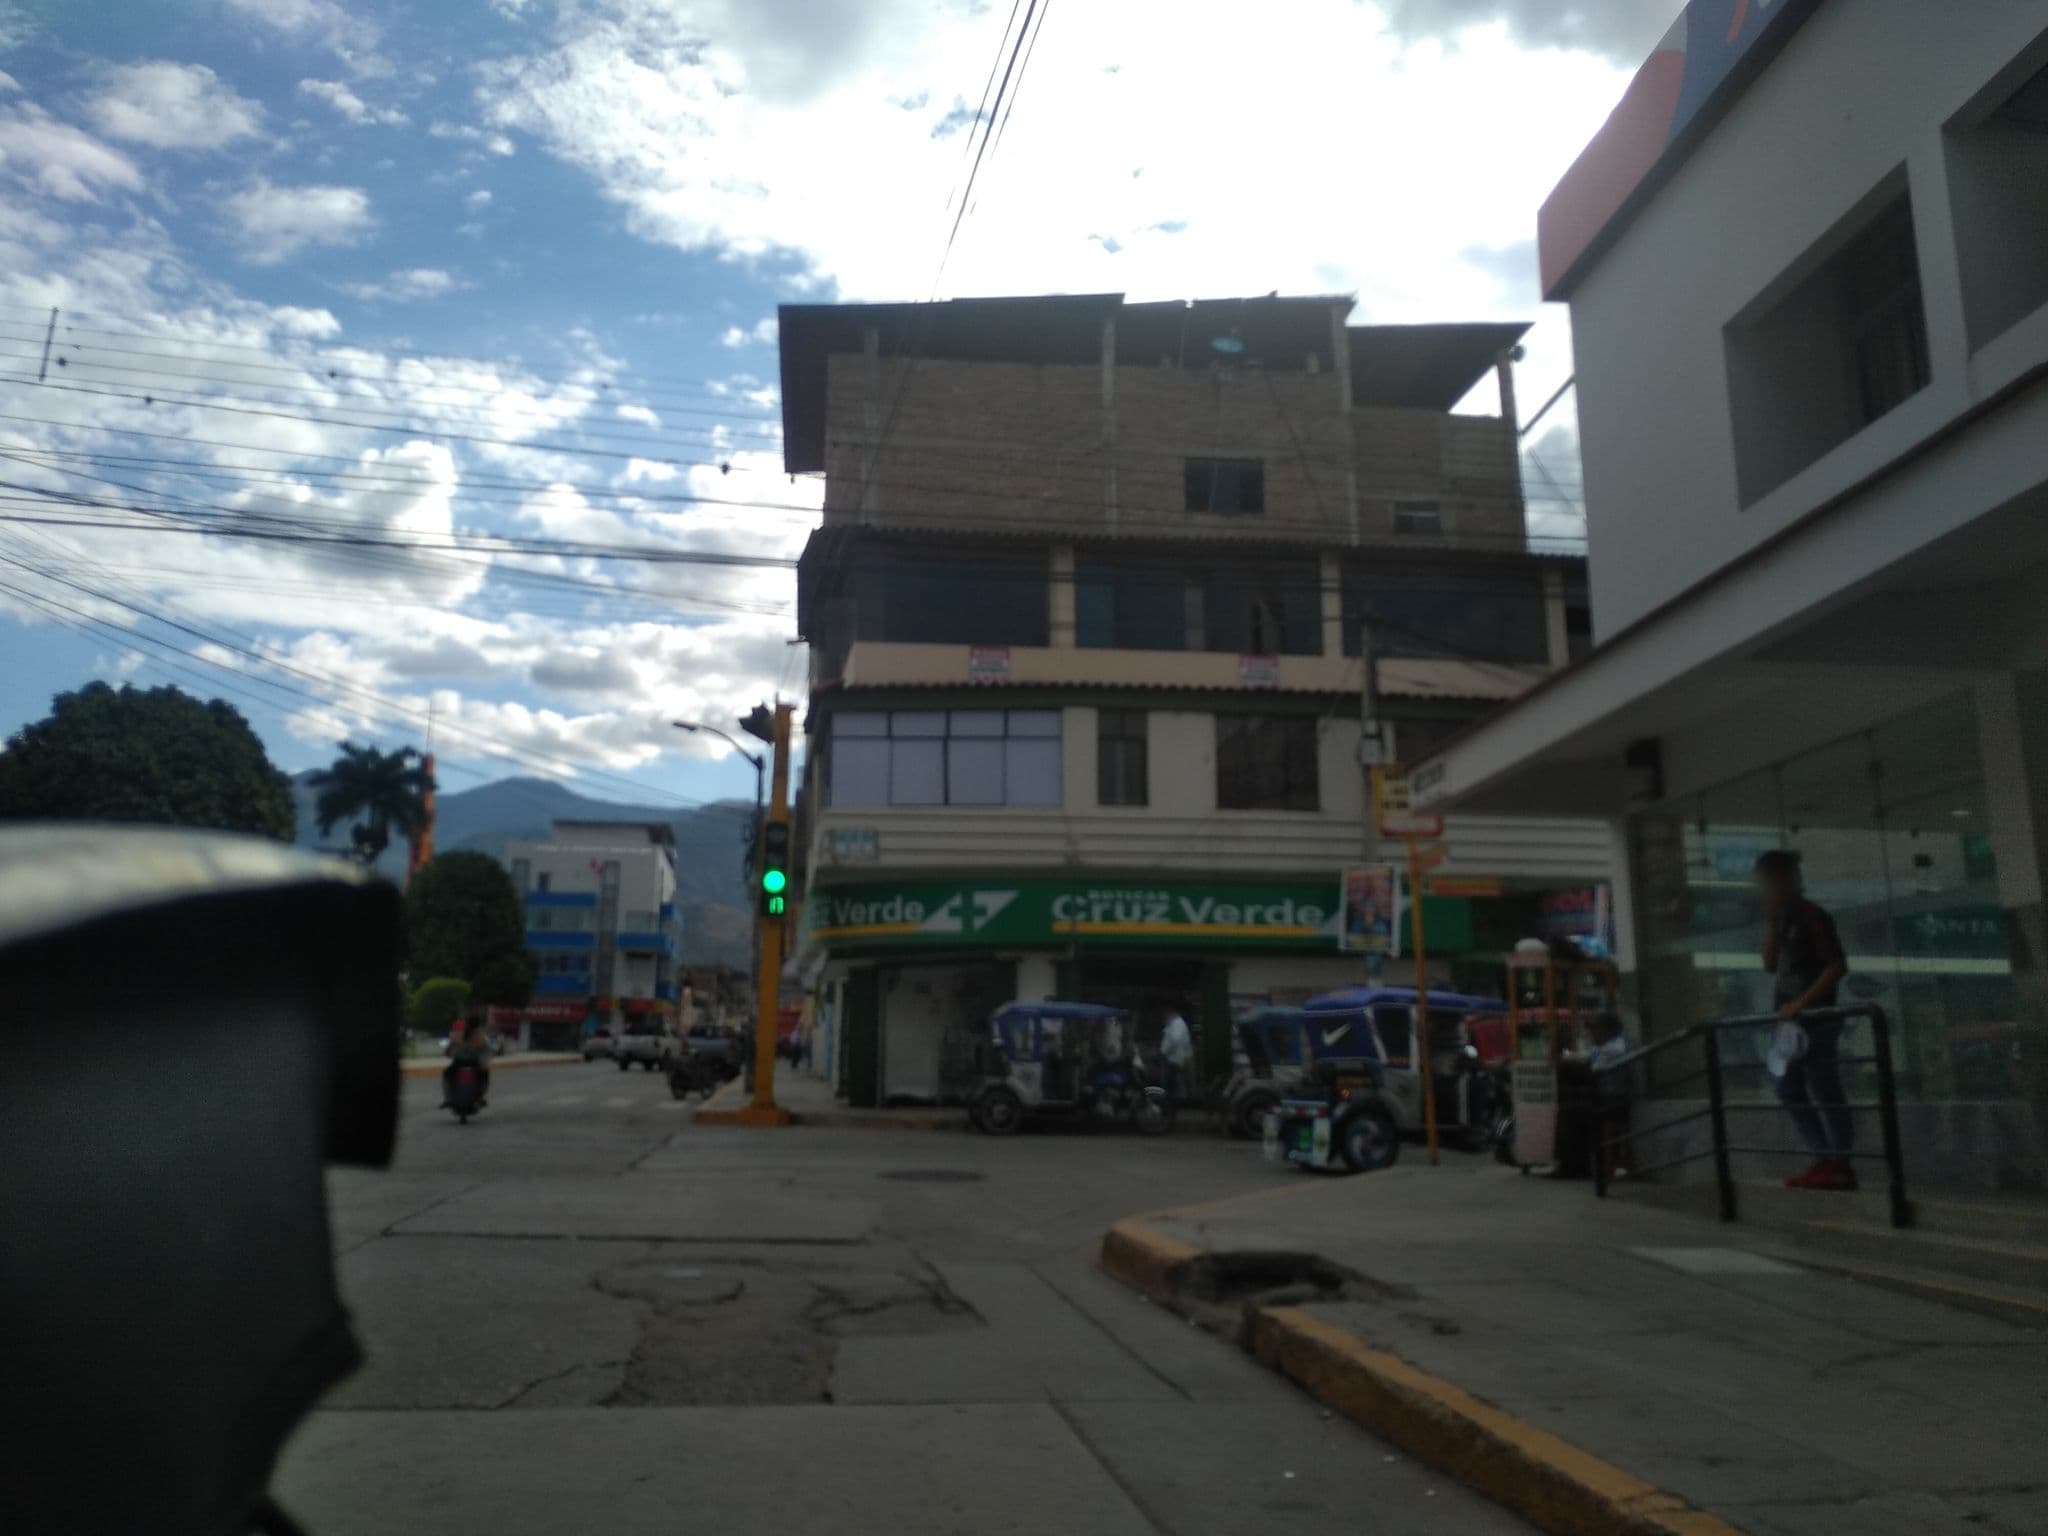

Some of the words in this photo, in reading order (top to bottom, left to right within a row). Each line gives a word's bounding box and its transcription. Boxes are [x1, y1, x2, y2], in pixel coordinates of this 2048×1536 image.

[834, 893, 926, 925] Verde
[1051, 894, 1171, 923] Cruz
[1179, 896, 1325, 926] Verde
